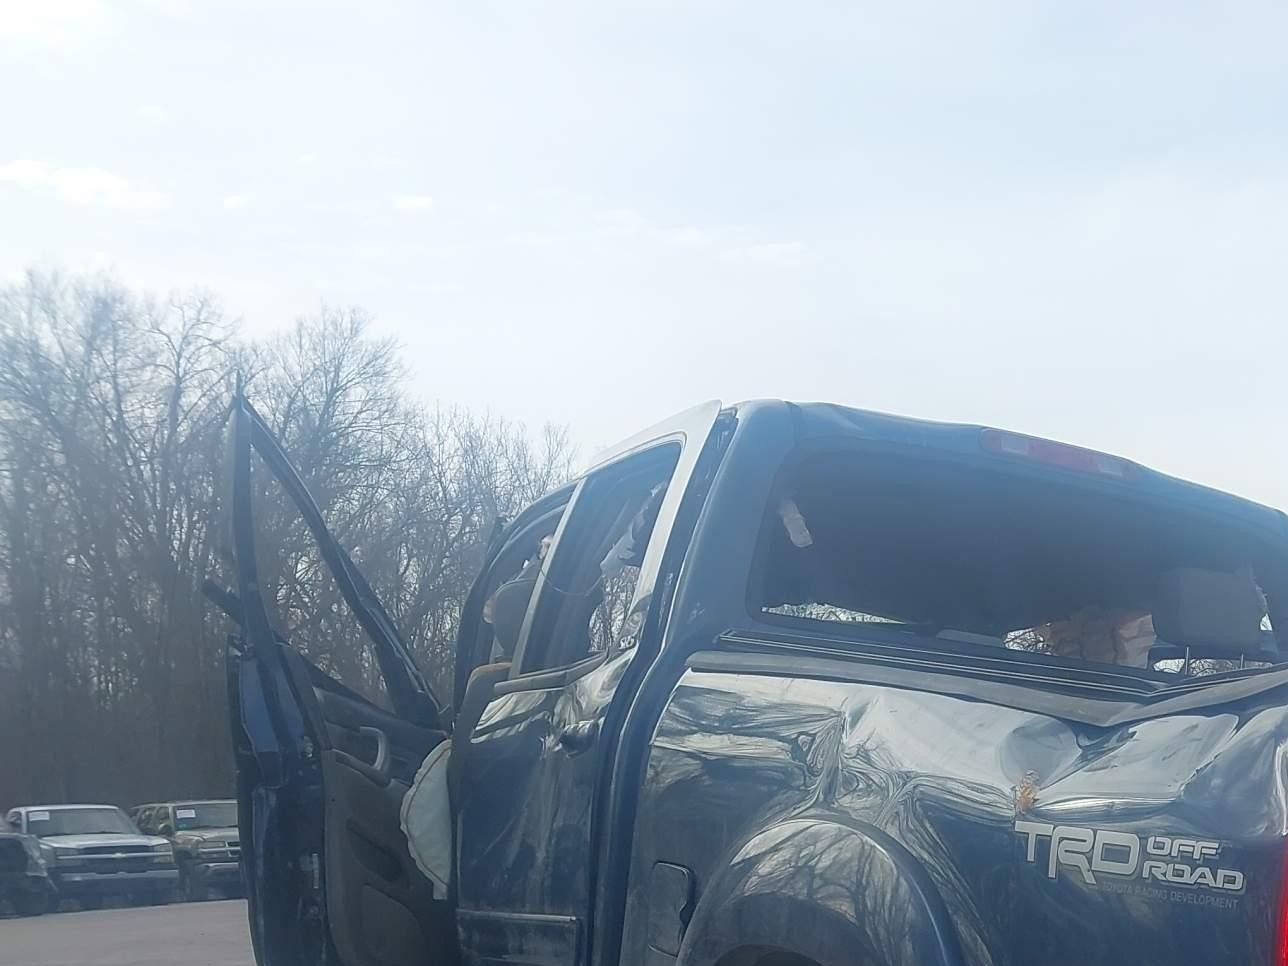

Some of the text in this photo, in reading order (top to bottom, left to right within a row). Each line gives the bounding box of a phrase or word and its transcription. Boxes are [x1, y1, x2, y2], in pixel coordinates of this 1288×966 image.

[1014, 821, 1140, 884] TRD
[1147, 836, 1219, 859] OFF
[1142, 861, 1244, 890] ROAD
[1170, 890, 1239, 910] DEVELOPMENT
